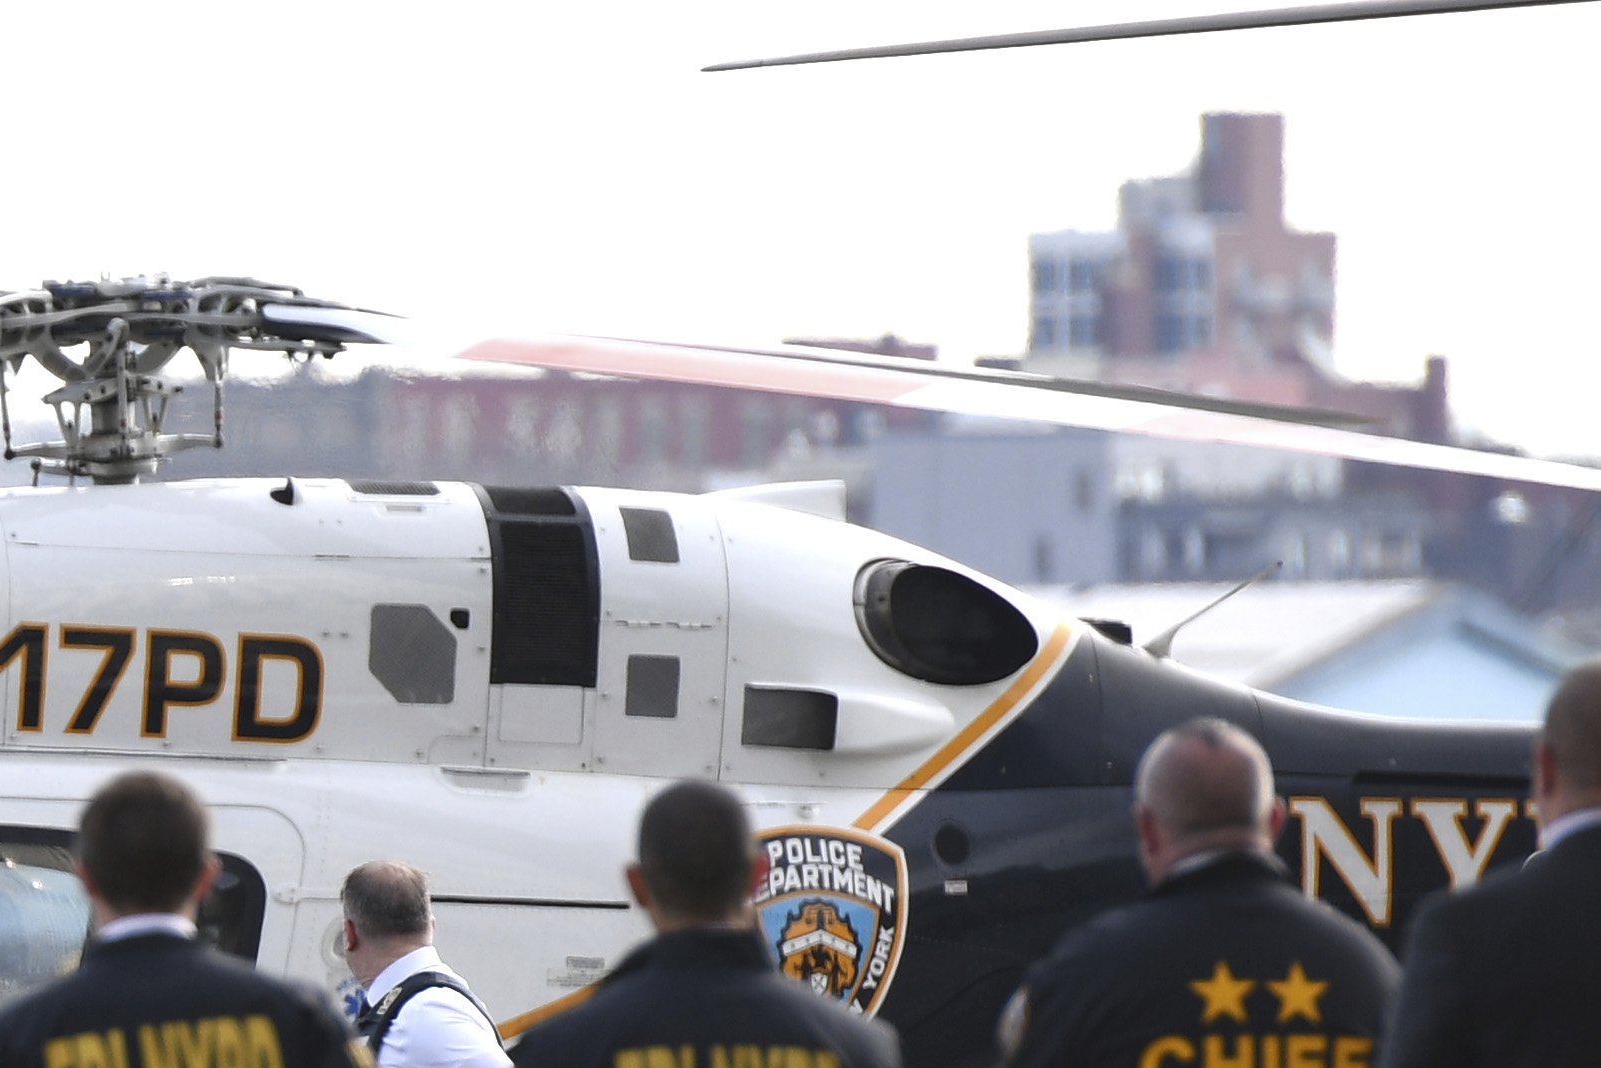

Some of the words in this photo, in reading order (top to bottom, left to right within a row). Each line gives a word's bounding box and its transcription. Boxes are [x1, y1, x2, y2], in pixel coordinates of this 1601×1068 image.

[767, 837, 864, 871] POLICE
[1289, 796, 1544, 927] NY
[755, 864, 894, 915] EPARTMENT
[862, 926, 895, 990] YORK
